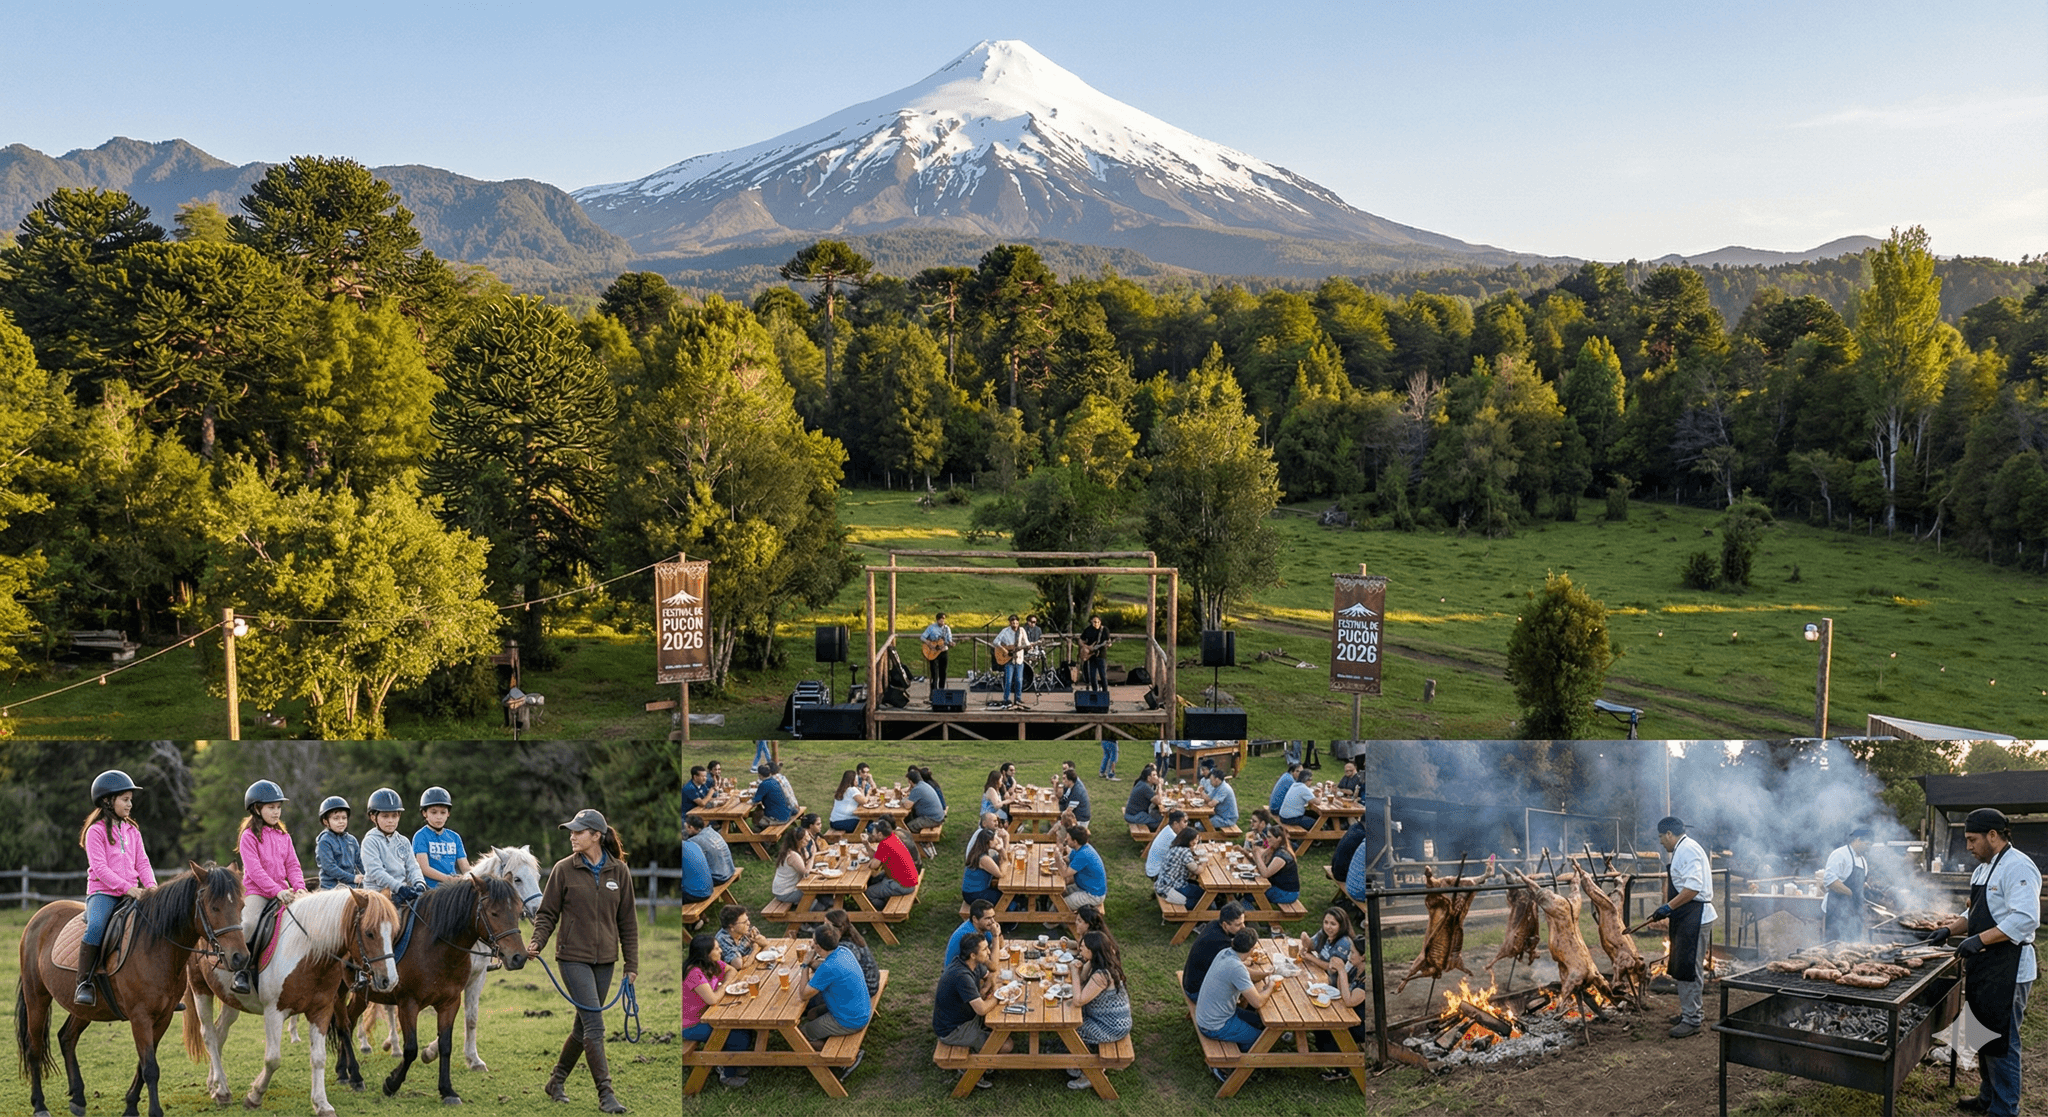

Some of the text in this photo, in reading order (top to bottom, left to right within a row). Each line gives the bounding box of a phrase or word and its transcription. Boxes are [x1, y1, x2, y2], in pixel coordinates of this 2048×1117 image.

[662, 606, 704, 617] FESTIVAL DE
[1338, 619, 1379, 631] FESTIVAL DE
[662, 631, 704, 651] 2026
[1338, 627, 1378, 645] PUCÓN
[1336, 642, 1378, 664] 2026
